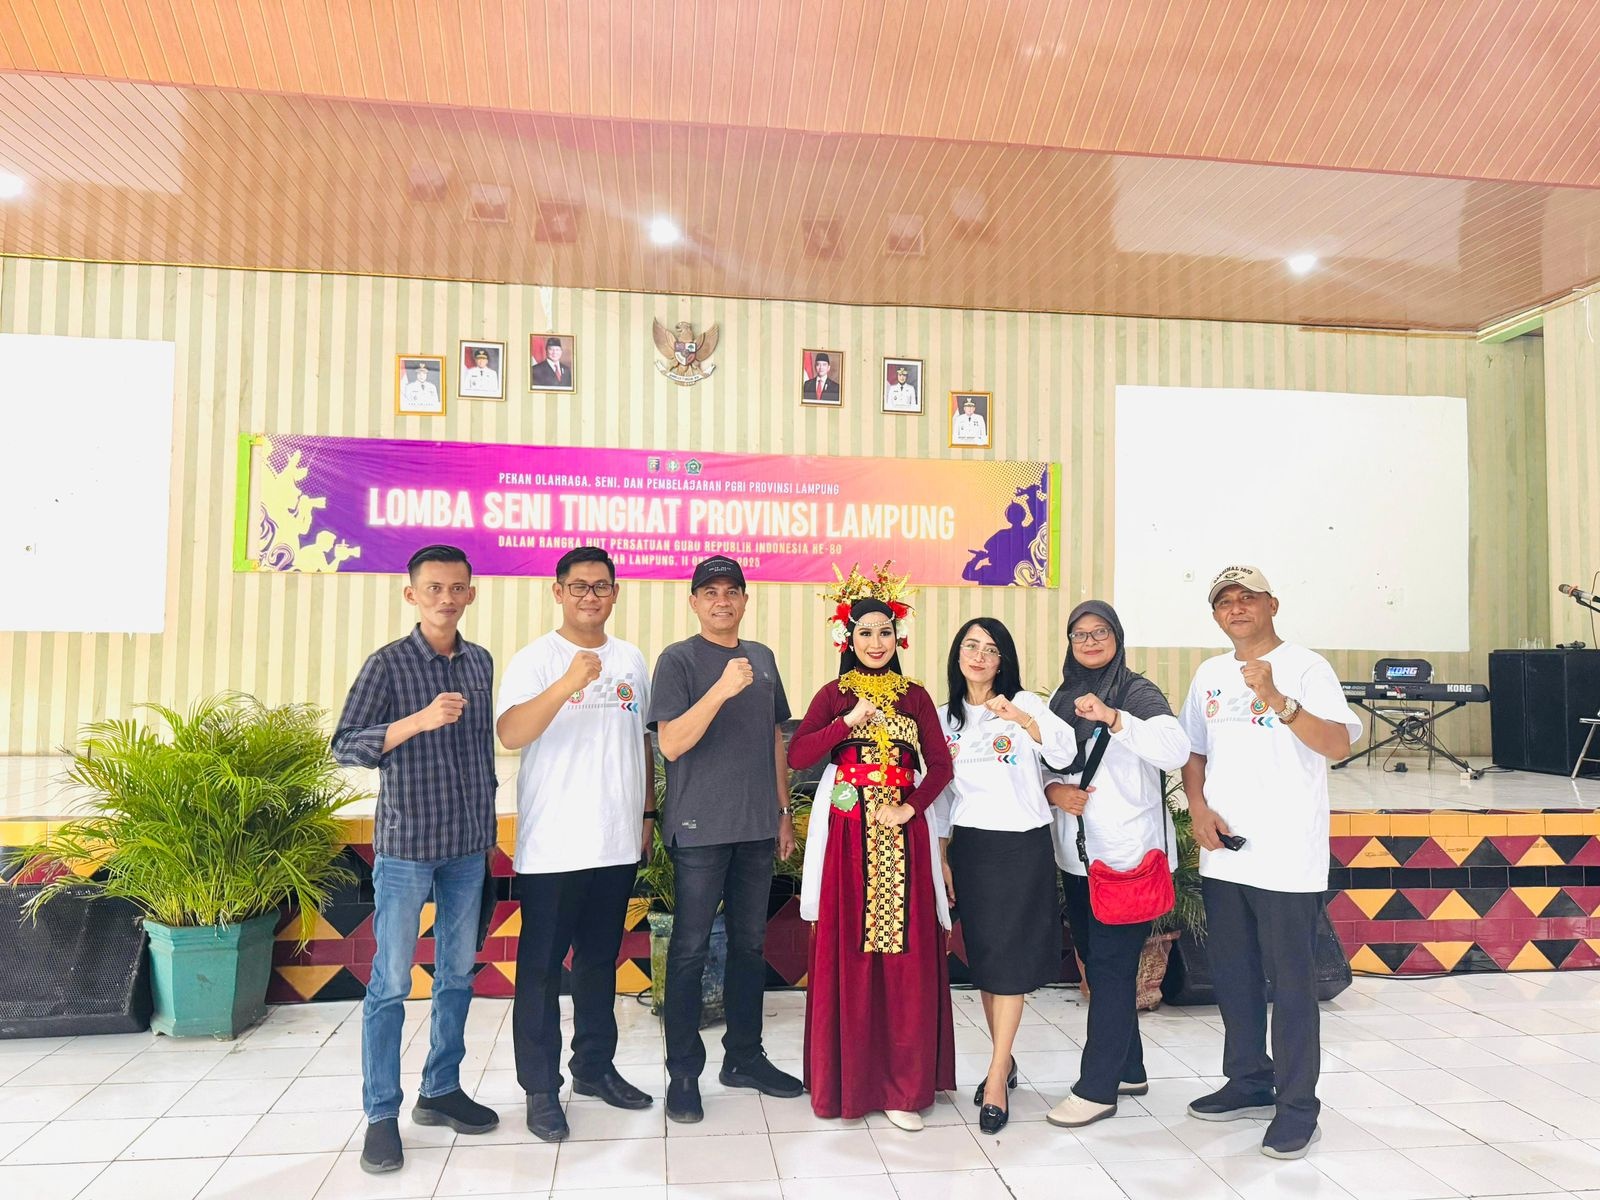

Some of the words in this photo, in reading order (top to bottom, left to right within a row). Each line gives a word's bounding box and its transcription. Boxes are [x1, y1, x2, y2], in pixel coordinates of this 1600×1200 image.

[499, 472, 532, 485] PEKAN
[624, 477, 644, 489] DAN
[647, 477, 722, 492] PEMBELAJARAN
[725, 480, 746, 493] PGRI
[749, 481, 793, 494] PROVINSI
[796, 482, 840, 495] LAMPUNG
[368, 487, 475, 528] LOMBA
[483, 491, 551, 531] SENI
[560, 494, 681, 534] TINGKAT
[689, 498, 818, 537] PROVINSI
[826, 502, 955, 540] LAMPUNG
[498, 535, 535, 548] DALAM
[539, 536, 582, 549] RANGKA
[586, 537, 606, 550] HUT
[610, 538, 670, 551] PERSATUAN
[674, 540, 701, 552] GURU
[704, 541, 751, 553] REPUBLIK
[756, 542, 809, 554] INDONESIA
[738, 556, 760, 568] 2025
[1386, 666, 1418, 676] KORG
[1446, 684, 1472, 693] KORG
